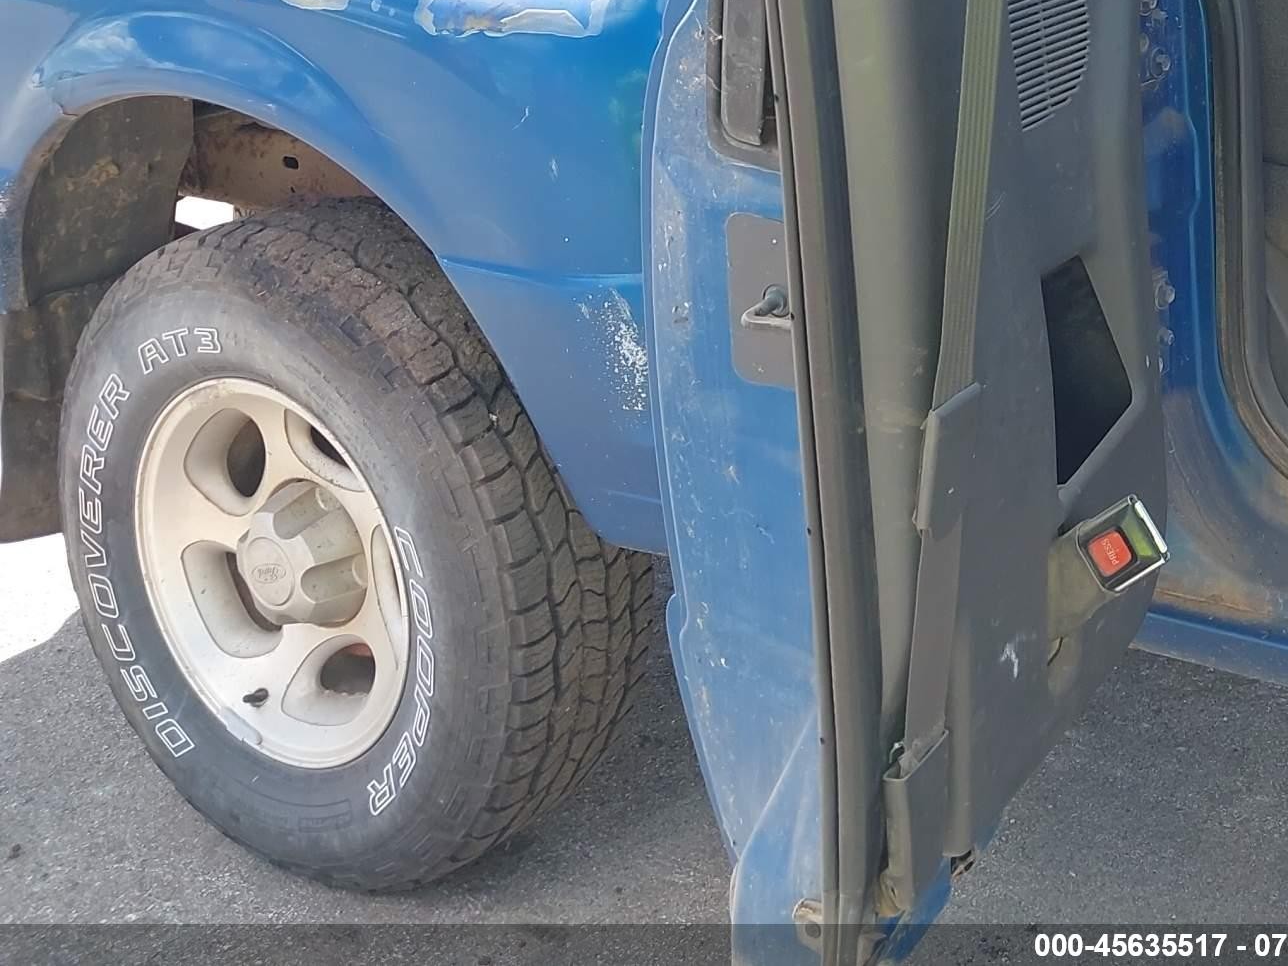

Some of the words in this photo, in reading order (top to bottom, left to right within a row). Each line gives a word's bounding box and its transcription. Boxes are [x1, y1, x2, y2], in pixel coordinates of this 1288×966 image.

[138, 325, 222, 375] AT3
[82, 373, 196, 758] DISCOVERER
[1102, 538, 1120, 567] PRESS
[368, 525, 436, 817] COOPER
